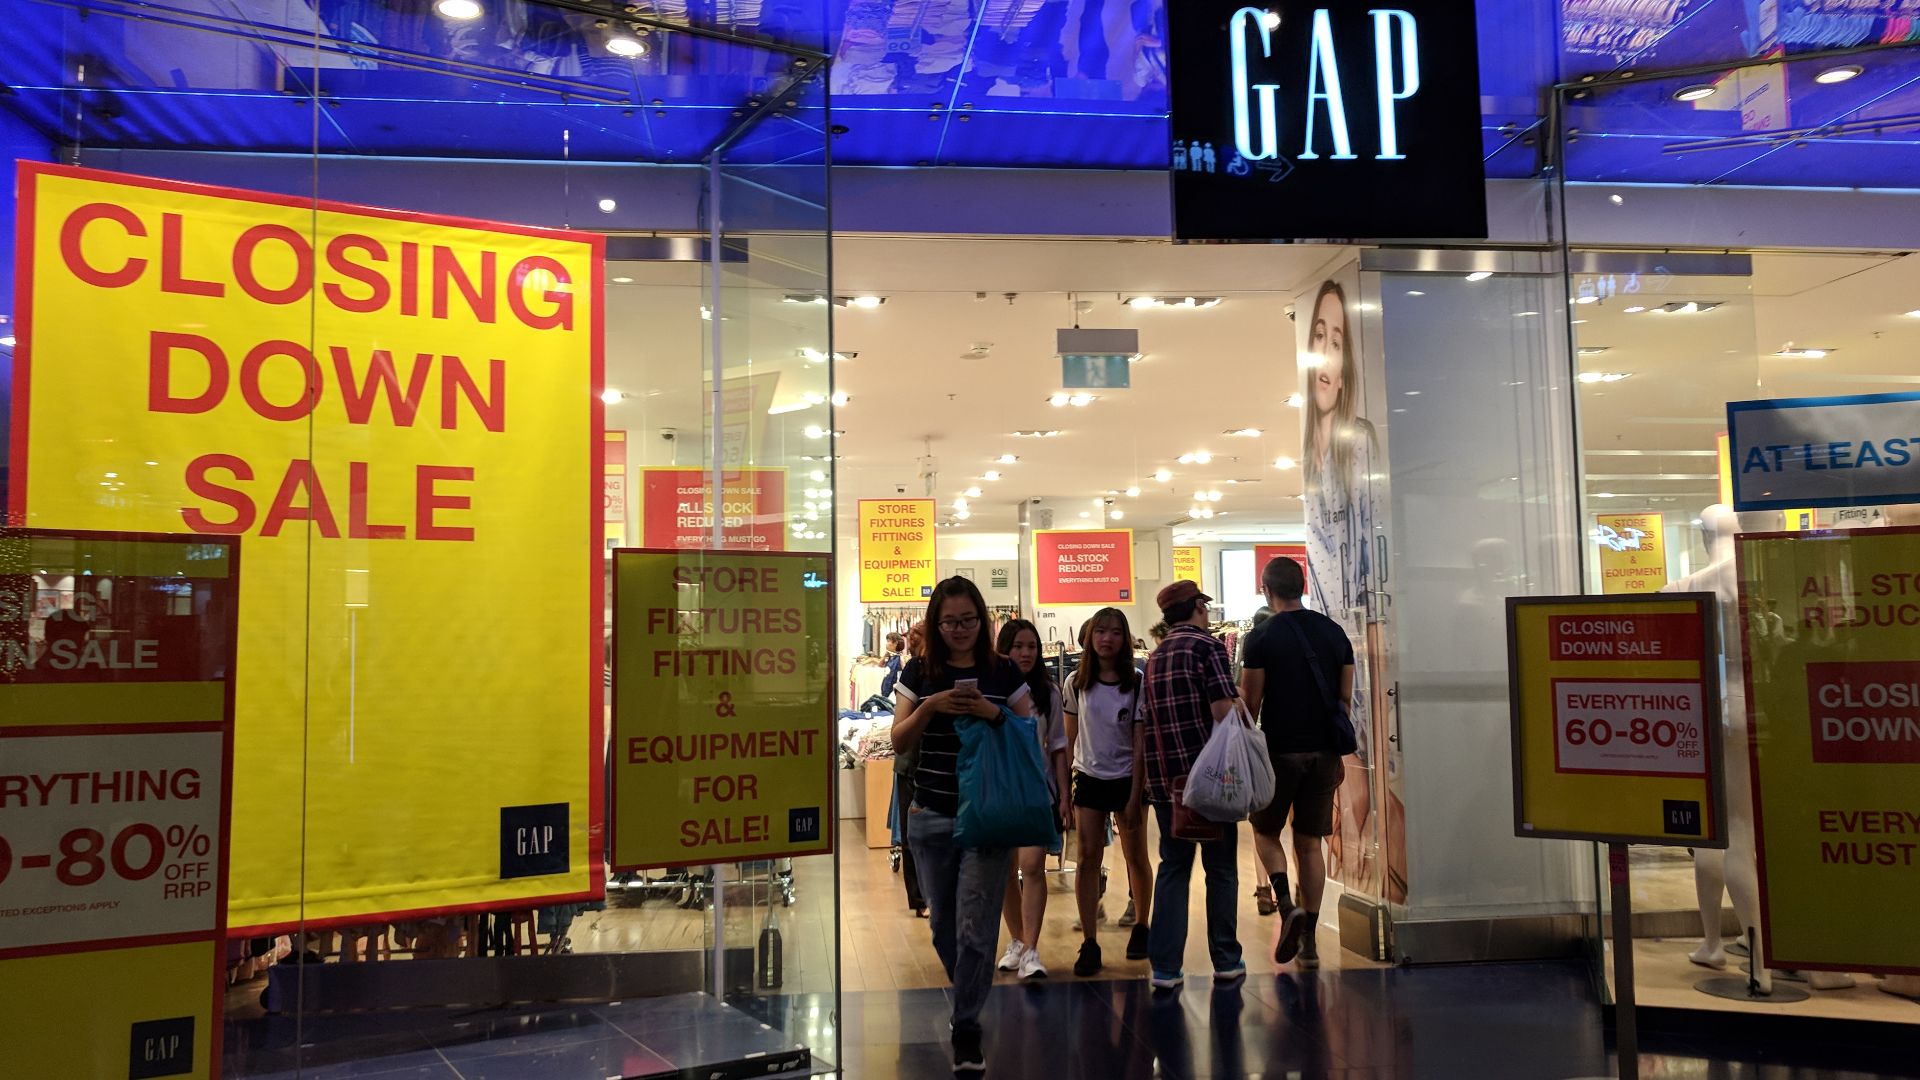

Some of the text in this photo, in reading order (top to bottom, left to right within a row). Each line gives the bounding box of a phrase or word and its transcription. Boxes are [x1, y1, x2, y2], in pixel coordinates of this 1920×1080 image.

[1230, 6, 1420, 160] GAP
[60, 202, 574, 332] CLOSING
[148, 331, 505, 433] DOWN
[1742, 445, 1790, 474] AT
[181, 453, 475, 541] SALE
[676, 487, 712, 495] CLOSING
[741, 487, 762, 495] SALE
[676, 502, 752, 514] ALL SOCK
[878, 504, 916, 514] STORE
[1839, 508, 1867, 520] Fitting
[676, 516, 743, 528] REDUED
[870, 518, 925, 528] FIXTURES
[872, 532, 924, 541] FITTINGS
[894, 545, 902, 555] &
[1058, 553, 1110, 563] ALL STOCK
[864, 560, 932, 569] EQUIPMENT
[1058, 564, 1104, 573] REDUCED
[1606, 567, 1663, 578] EQUIPMENT
[672, 567, 779, 593] STORE
[886, 574, 910, 582] FOR
[1625, 580, 1646, 589] FOR
[1801, 573, 1920, 598] ALL ST
[882, 587, 915, 596] SALE!
[648, 607, 802, 634] FIXTURES
[1559, 620, 1635, 636] CLOSING
[50, 638, 160, 670] SALE
[1560, 640, 1662, 655] DOWN SALE
[653, 648, 797, 678] FITTINGS
[1567, 694, 1691, 711] EVERYTHING
[1819, 683, 1920, 708] CLOSI
[715, 691, 737, 718] &
[627, 730, 820, 765] EQUIPMENT
[1677, 741, 1698, 749] OFF
[1677, 750, 1700, 758] RRP
[0, 767, 201, 809] RYTHING
[693, 774, 758, 804] FOR
[795, 817, 813, 833] GAP
[1671, 809, 1692, 825] GAP
[680, 816, 770, 848] SALE!
[517, 825, 553, 857] GAP
[1821, 841, 1917, 866] MUST
[164, 861, 210, 881] OFF
[163, 881, 212, 900] RRP
[23, 903, 87, 916] EXCEPTIONS
[89, 901, 121, 911] APPLY
[144, 1034, 180, 1062] GAP
